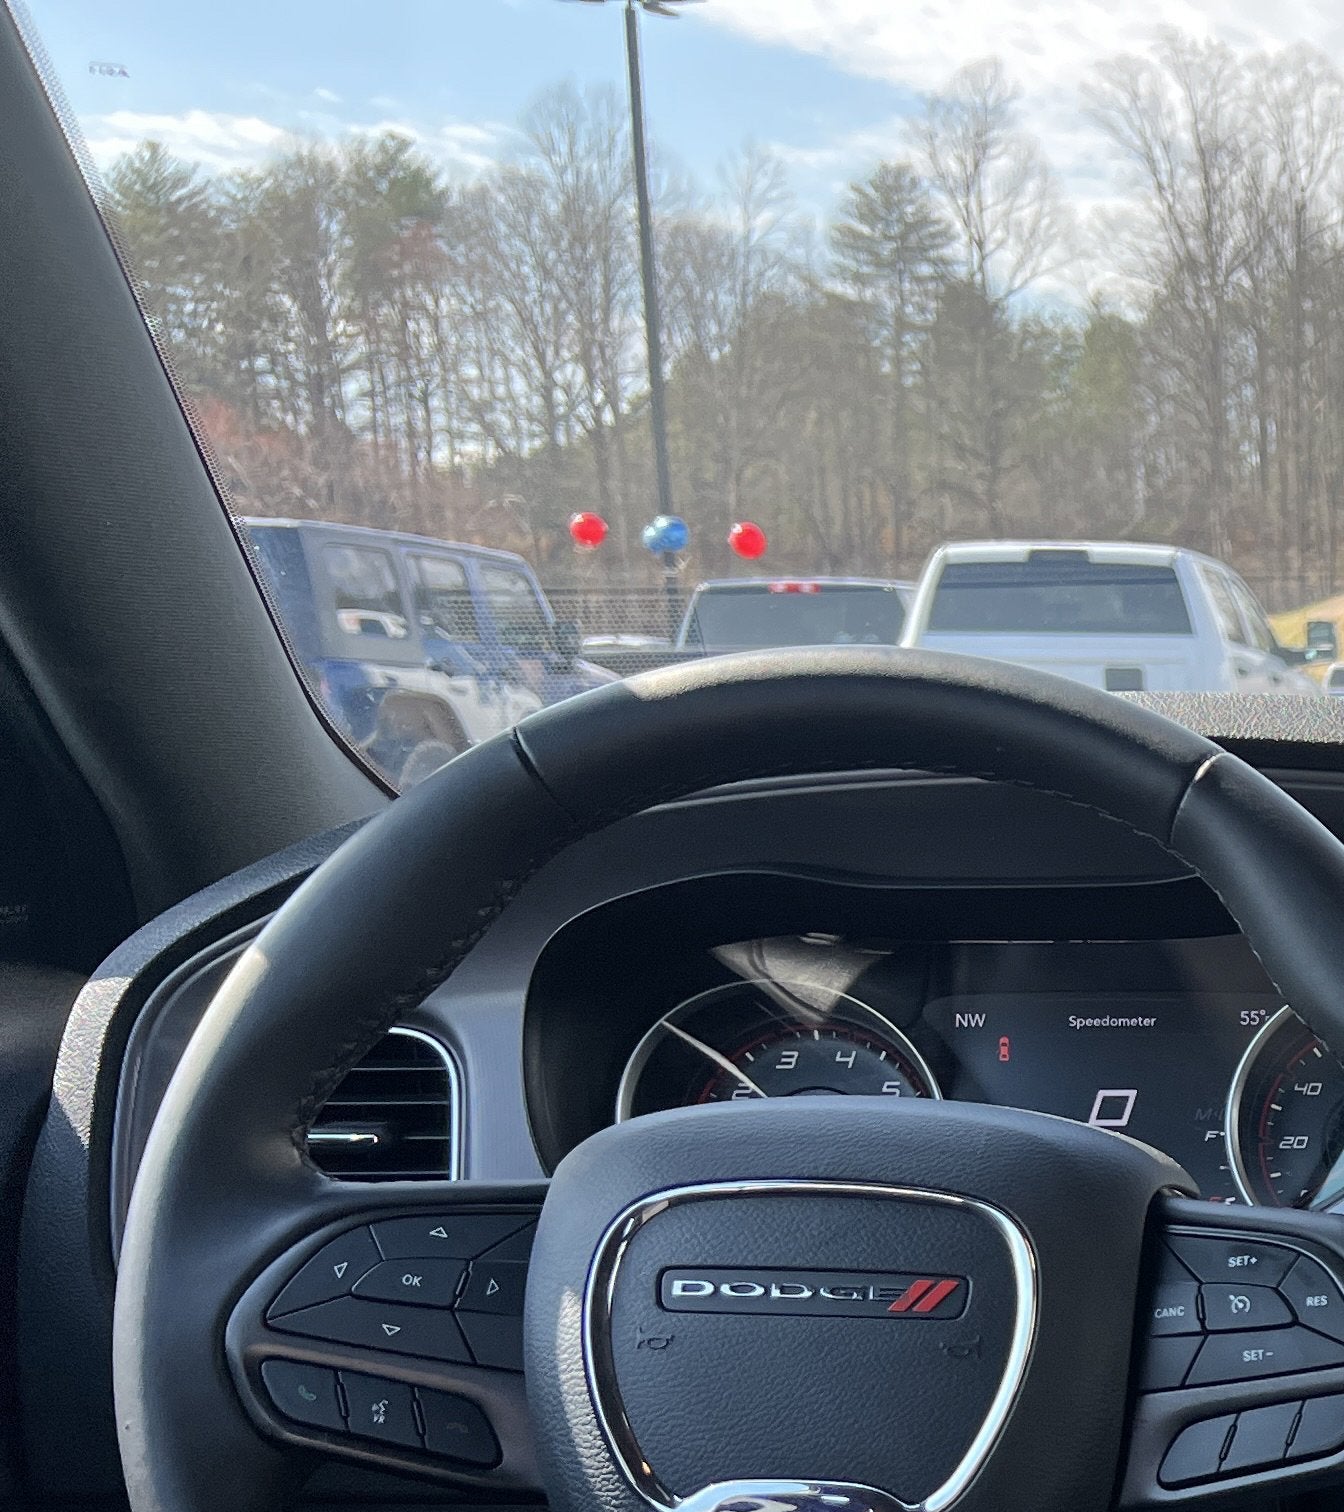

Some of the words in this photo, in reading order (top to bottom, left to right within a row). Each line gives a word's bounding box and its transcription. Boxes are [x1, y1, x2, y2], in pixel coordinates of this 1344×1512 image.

[955, 1013, 986, 1028] NW
[1068, 1015, 1156, 1029] Speedometer
[776, 1051, 798, 1069] 3
[835, 1051, 856, 1068] 4
[881, 1081, 900, 1097] 5
[1294, 1082, 1322, 1096] 40
[1089, 1088, 1138, 1127] 0
[1279, 1136, 1309, 1150] 20
[1228, 1255, 1257, 1267] SET+
[402, 1274, 423, 1287] OK
[671, 1280, 907, 1301] DODGE
[1306, 1295, 1328, 1306] RES
[1154, 1306, 1185, 1318] CANC
